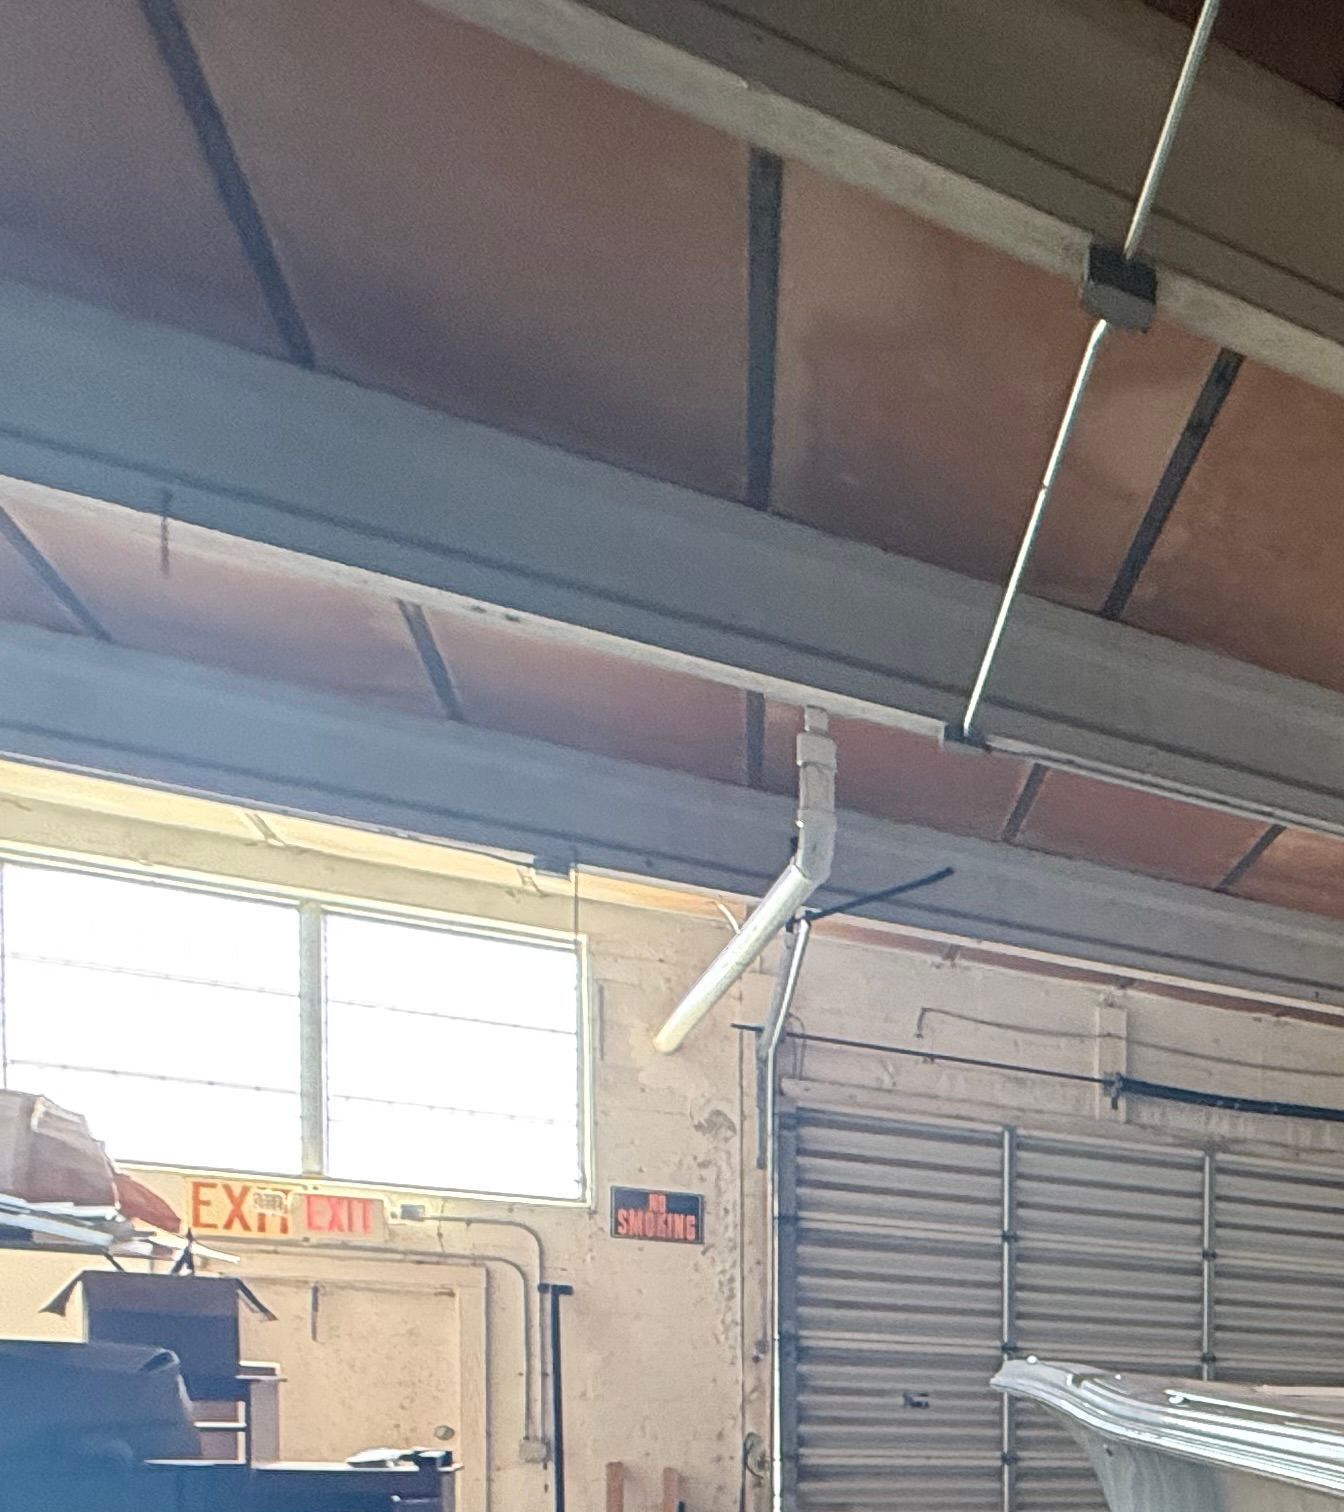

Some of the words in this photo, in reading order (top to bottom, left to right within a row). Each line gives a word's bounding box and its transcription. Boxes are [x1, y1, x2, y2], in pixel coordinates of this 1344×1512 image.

[191, 1181, 291, 1235] EXIT
[304, 1194, 373, 1233] EXIT
[648, 1193, 667, 1214] NO
[617, 1208, 696, 1241] SMOKING
